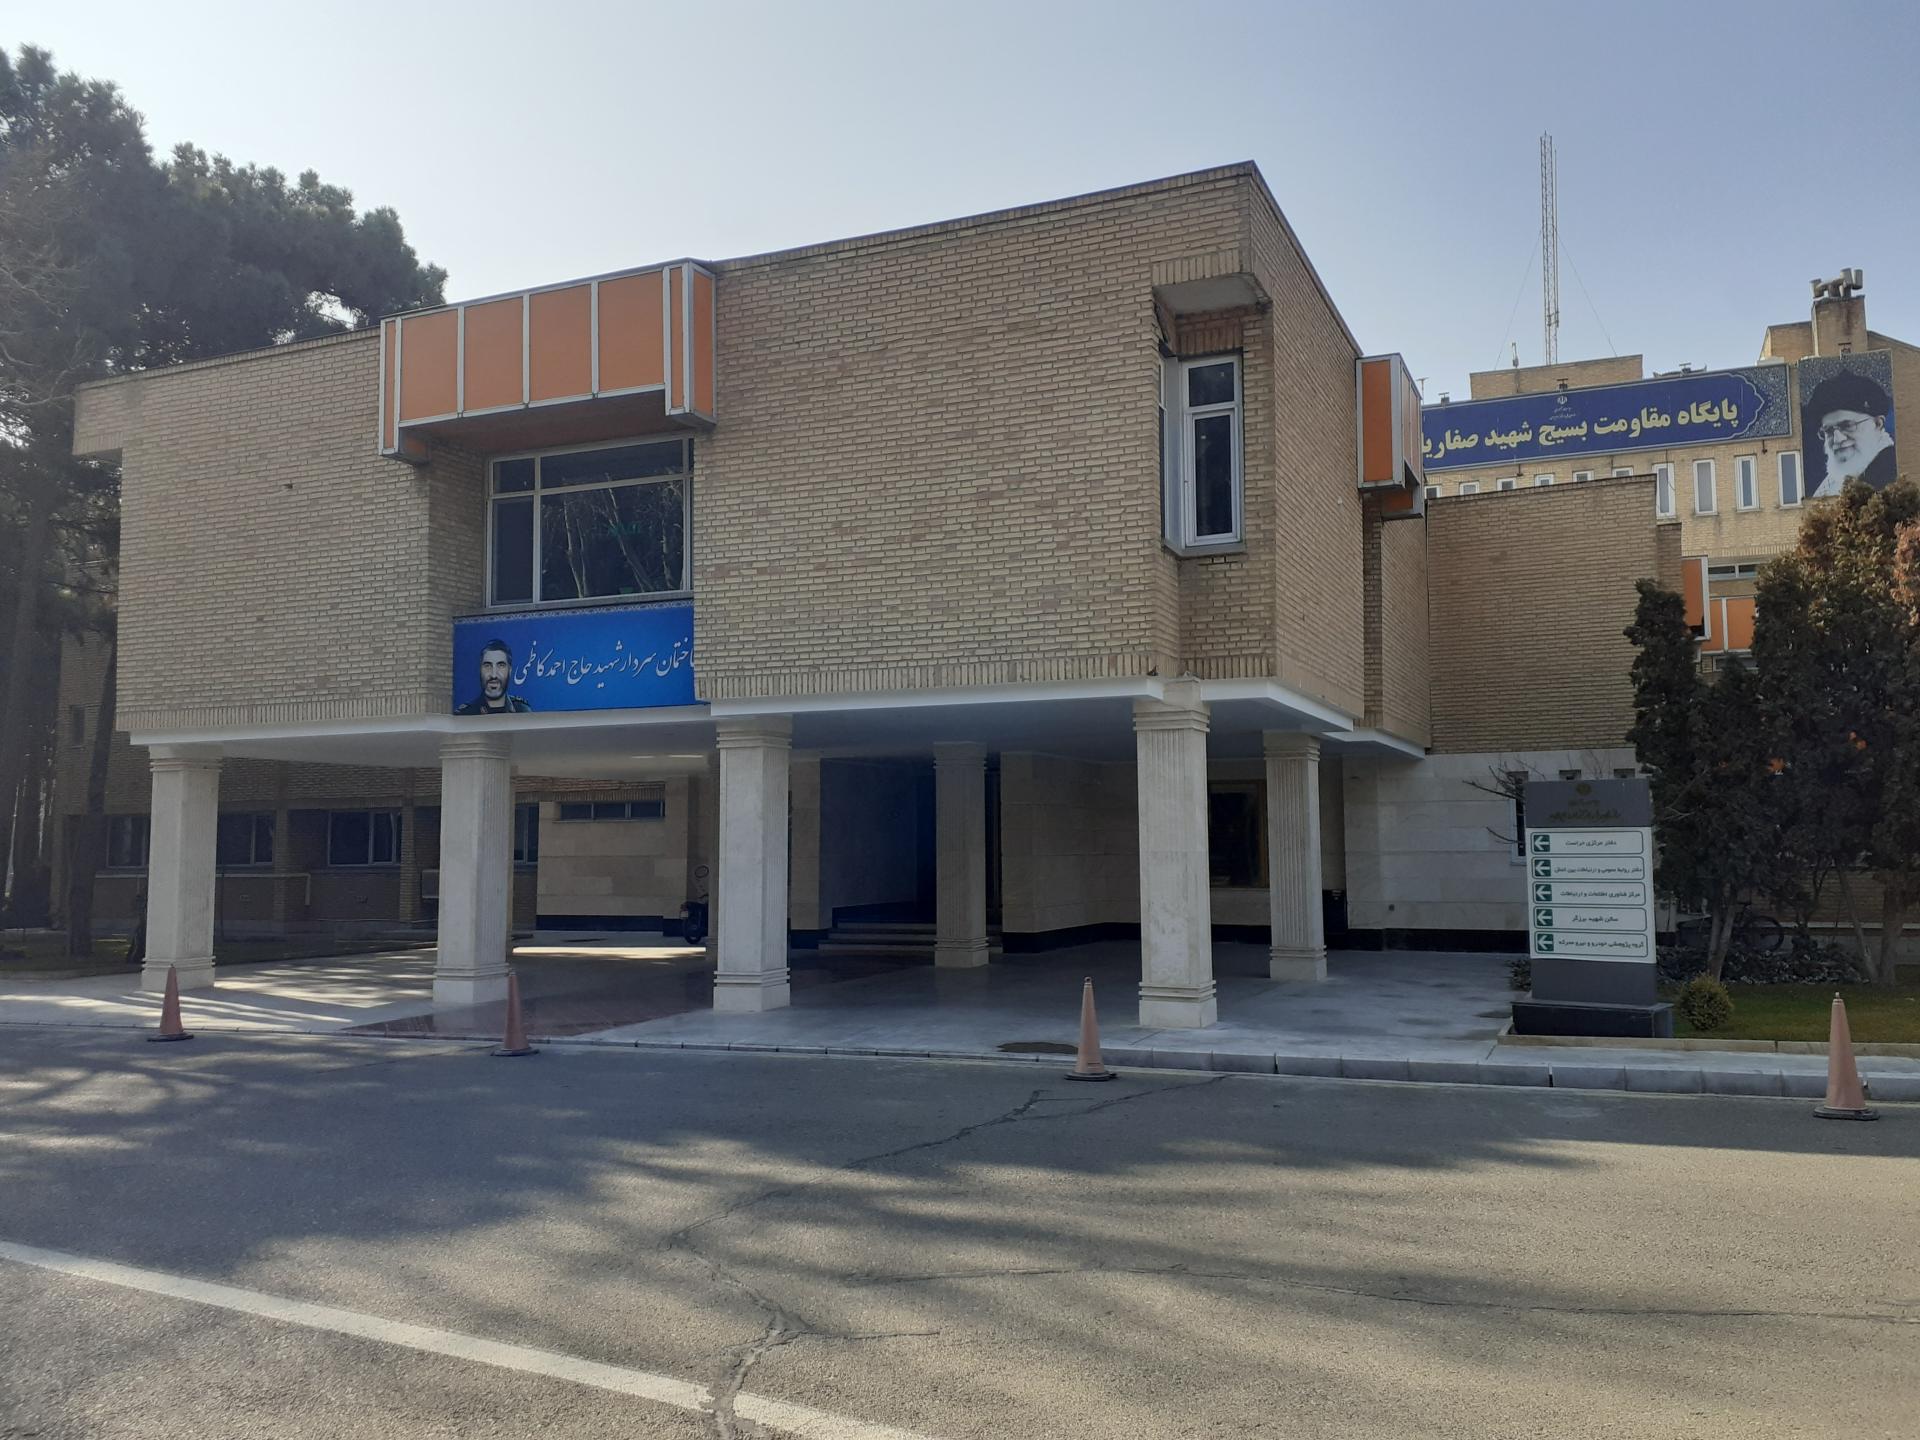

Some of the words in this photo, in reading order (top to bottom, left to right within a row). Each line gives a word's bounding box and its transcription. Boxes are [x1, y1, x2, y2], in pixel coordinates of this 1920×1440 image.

[1593, 407, 1671, 438] مقاومت
[1677, 398, 1739, 428] پایگاه
[1421, 429, 1479, 459] صفاریا
[1484, 421, 1533, 450] شهید
[1538, 420, 1588, 446] بسیج
[514, 640, 554, 685] کاظمی
[545, 658, 566, 677] احمد
[567, 656, 593, 685] حاج
[592, 640, 623, 689] شهید
[620, 651, 657, 678] سردار
[656, 637, 694, 677] اختمان
